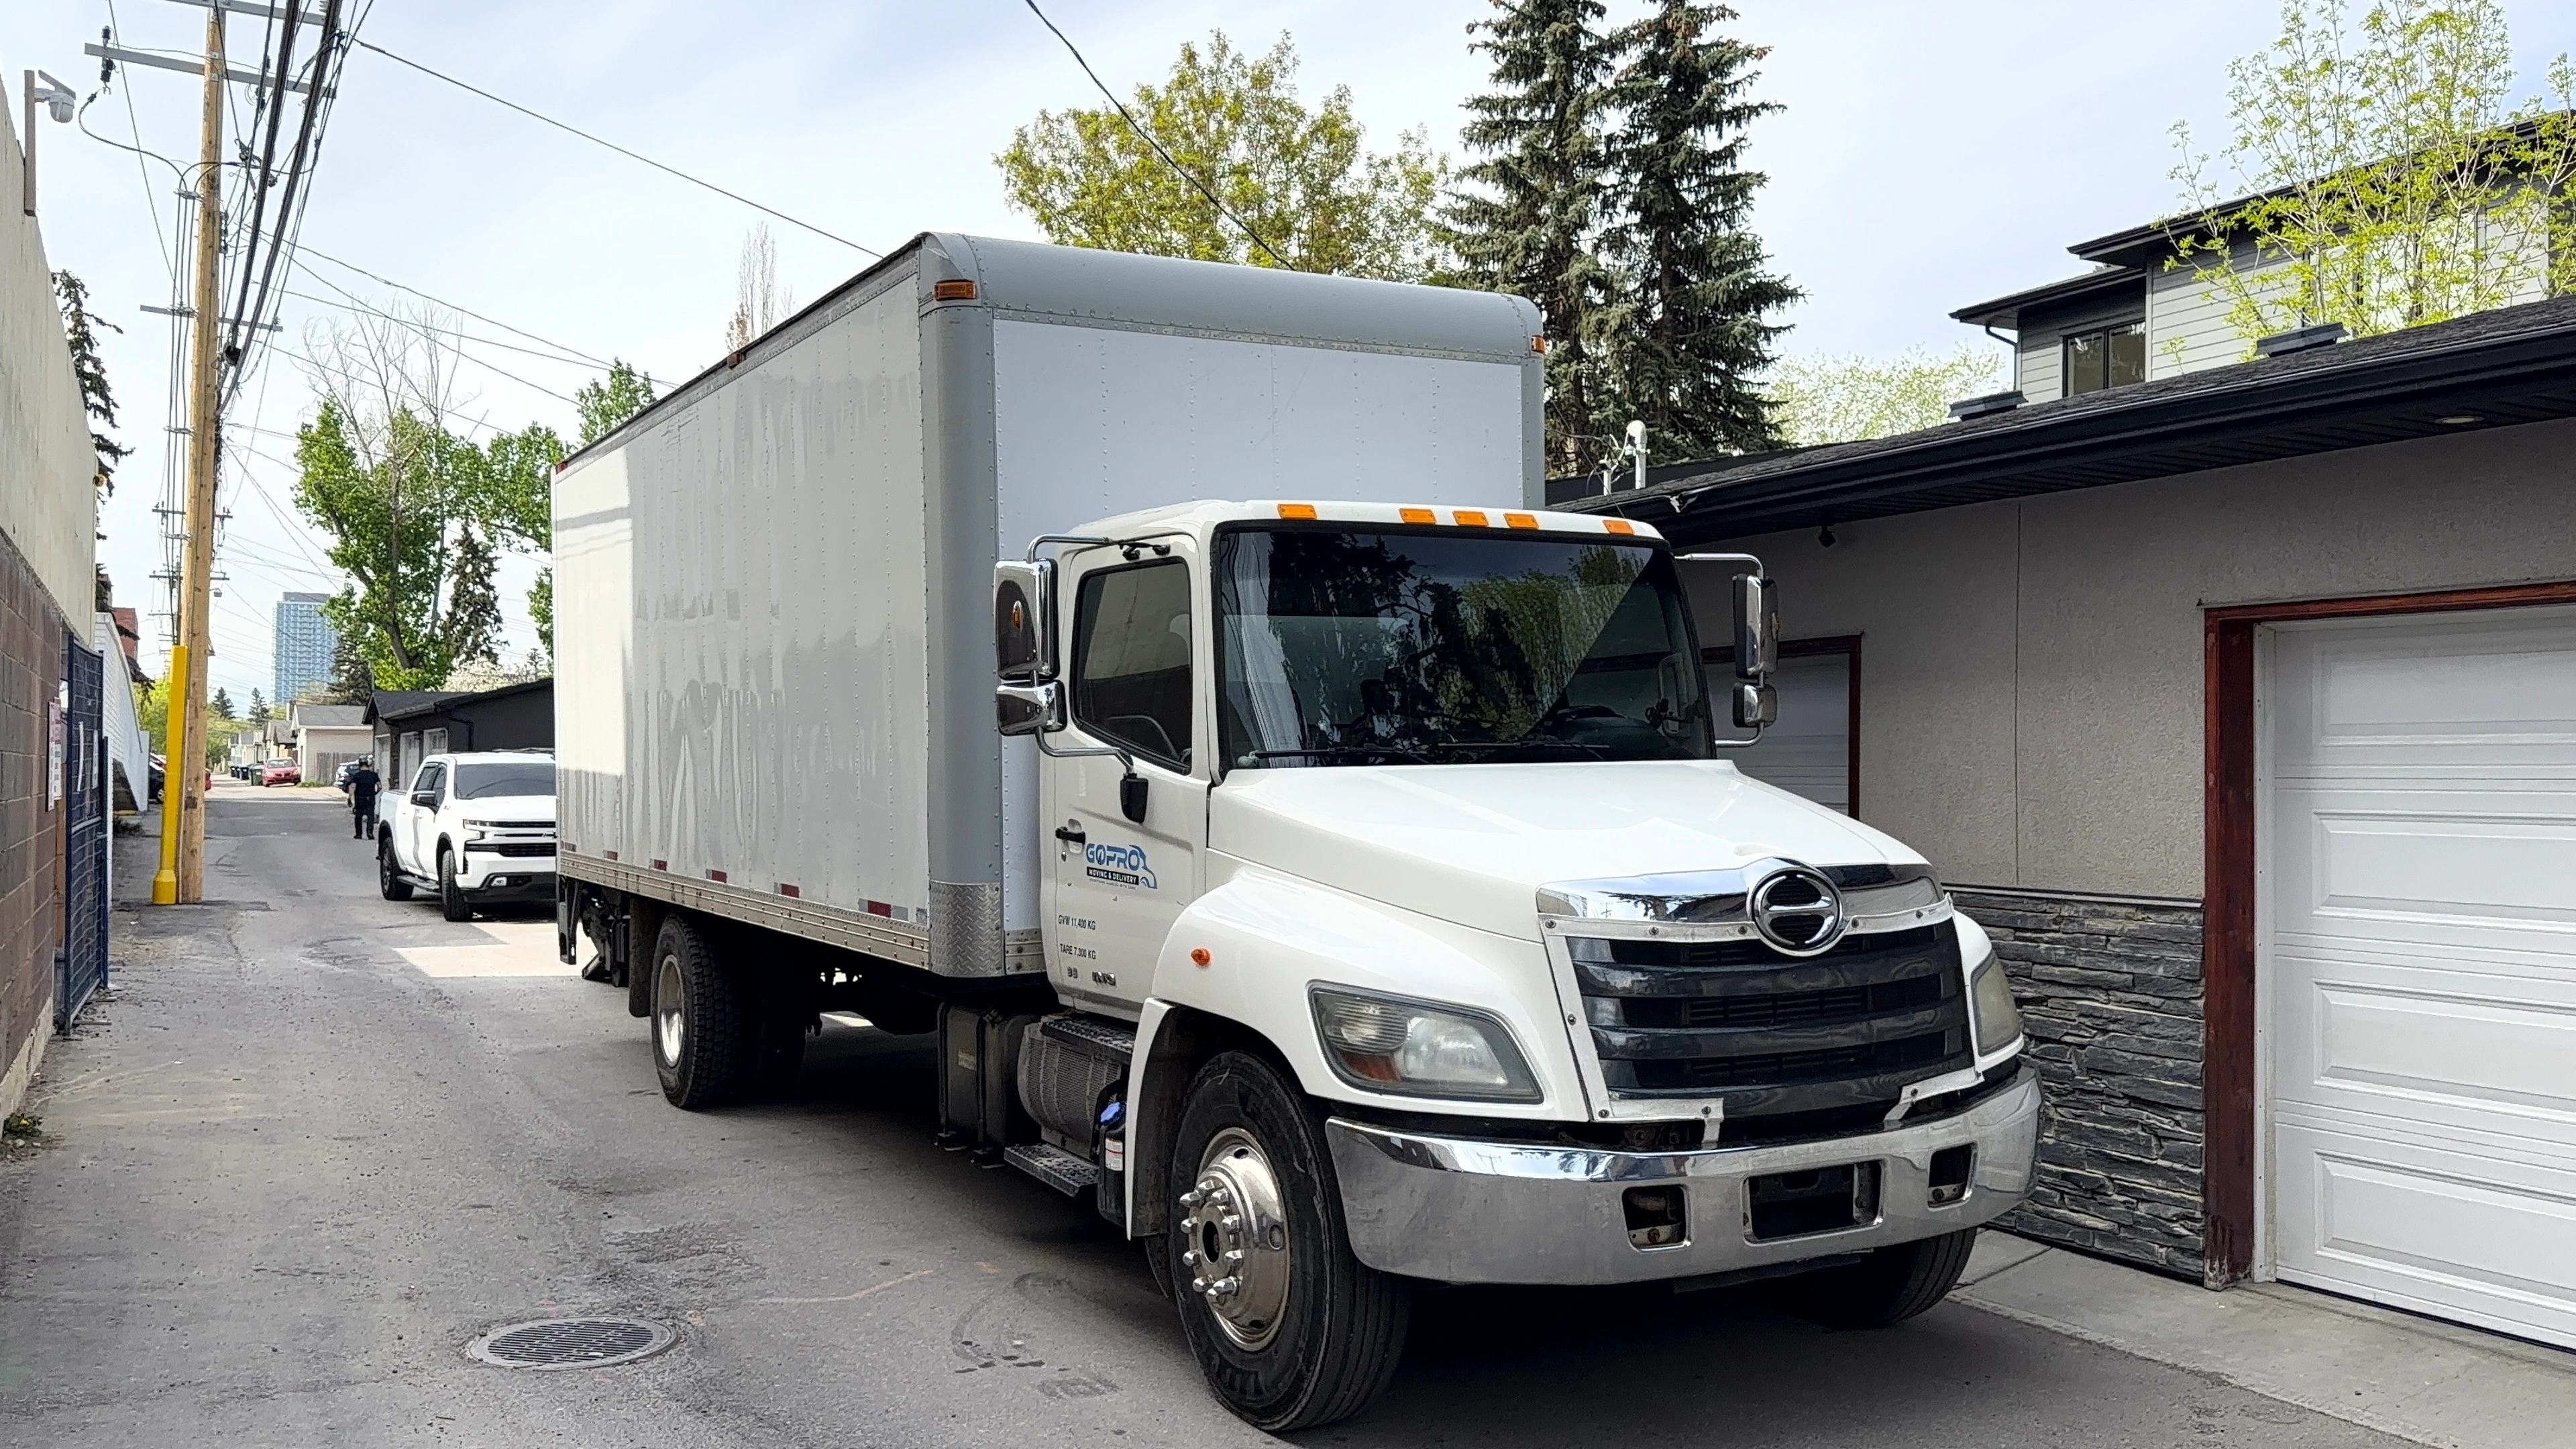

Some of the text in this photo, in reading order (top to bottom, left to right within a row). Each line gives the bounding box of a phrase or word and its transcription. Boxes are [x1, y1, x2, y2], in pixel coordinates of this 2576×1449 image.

[1086, 843, 1140, 871] GOPRO
[1088, 868, 1108, 879] MOVING
[1108, 871, 1112, 879] &
[1112, 872, 1137, 884] DELIVERY
[1058, 914, 1096, 930] GVW 11,400 KG
[1059, 943, 1073, 955] TARE
[1087, 949, 1096, 960] KG
